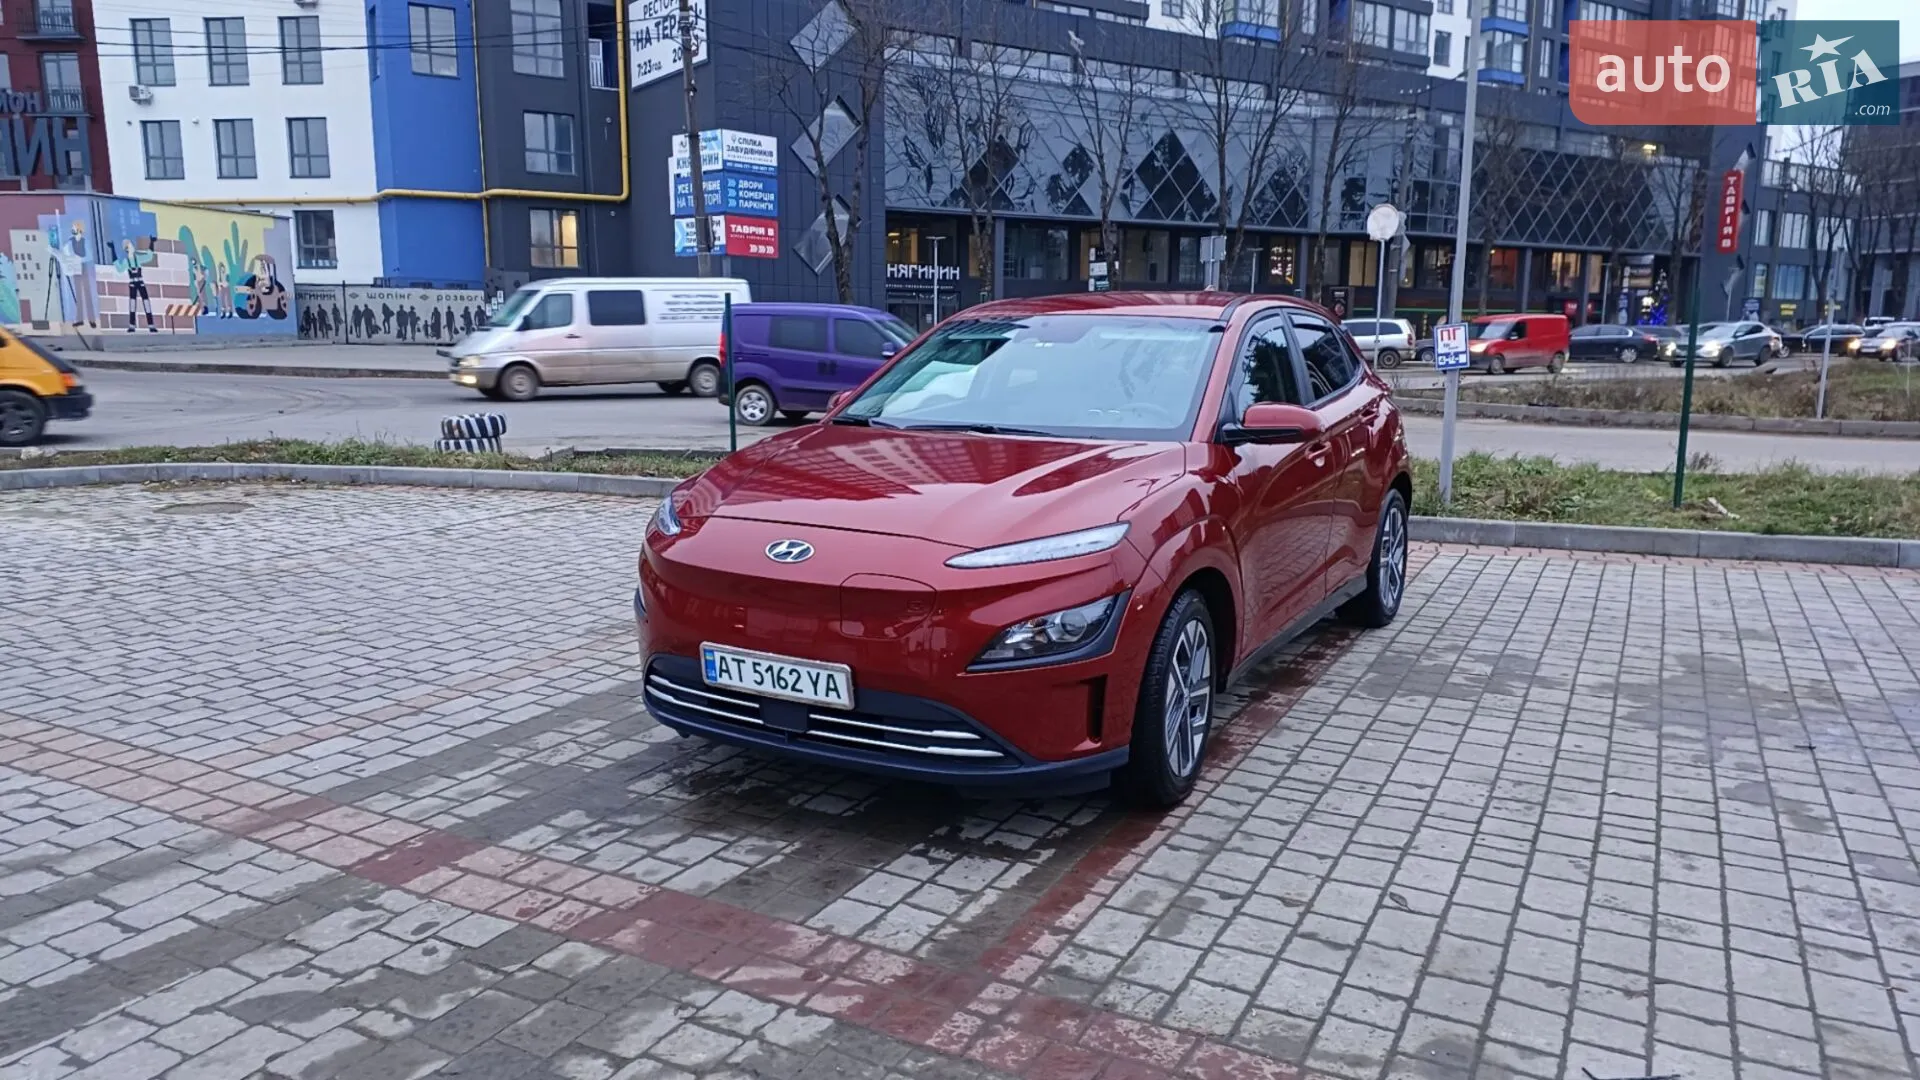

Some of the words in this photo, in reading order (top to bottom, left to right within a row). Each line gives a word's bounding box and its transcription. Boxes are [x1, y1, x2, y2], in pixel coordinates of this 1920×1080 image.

[738, 179, 763, 189] ДВОРИ
[738, 190, 775, 201] КОМЕРЦІЯ
[738, 199, 774, 211] ПАРКІНГИ
[886, 263, 960, 280] НЯГИНИН
[718, 655, 745, 682] AT
[752, 661, 804, 694] 5162
[807, 670, 842, 700] YA
